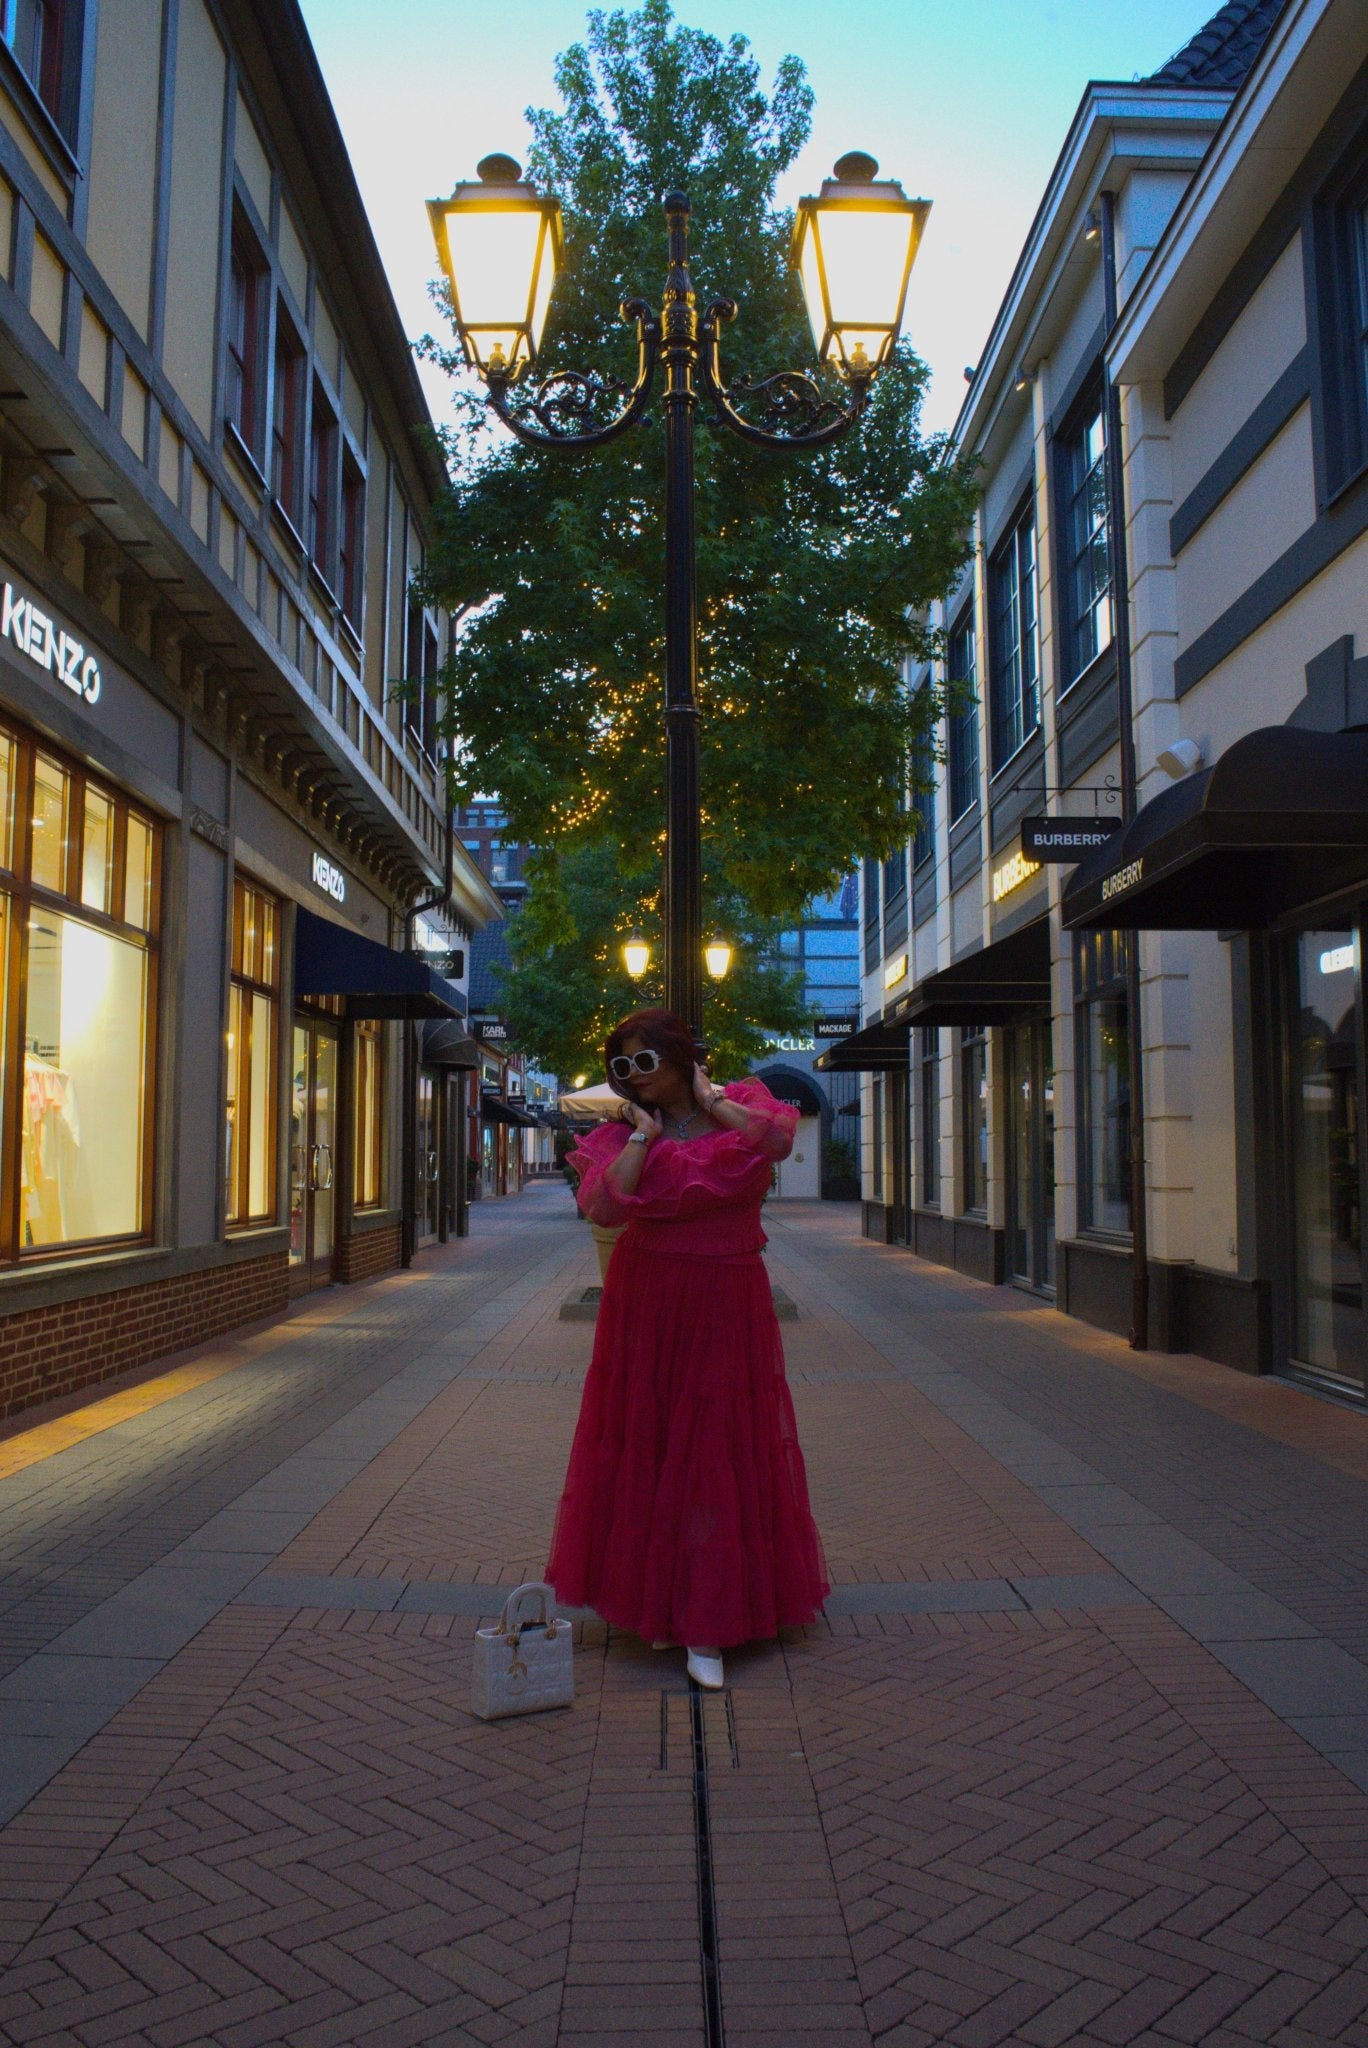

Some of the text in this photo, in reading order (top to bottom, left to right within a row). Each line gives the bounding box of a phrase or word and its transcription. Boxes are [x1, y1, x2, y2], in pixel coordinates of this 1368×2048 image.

[2, 582, 100, 704] KENZO
[313, 852, 344, 902] KENZO
[1102, 857, 1143, 901] BURBERRY
[482, 1025, 504, 1033] KARL
[818, 1024, 852, 1033] MACKAGE
